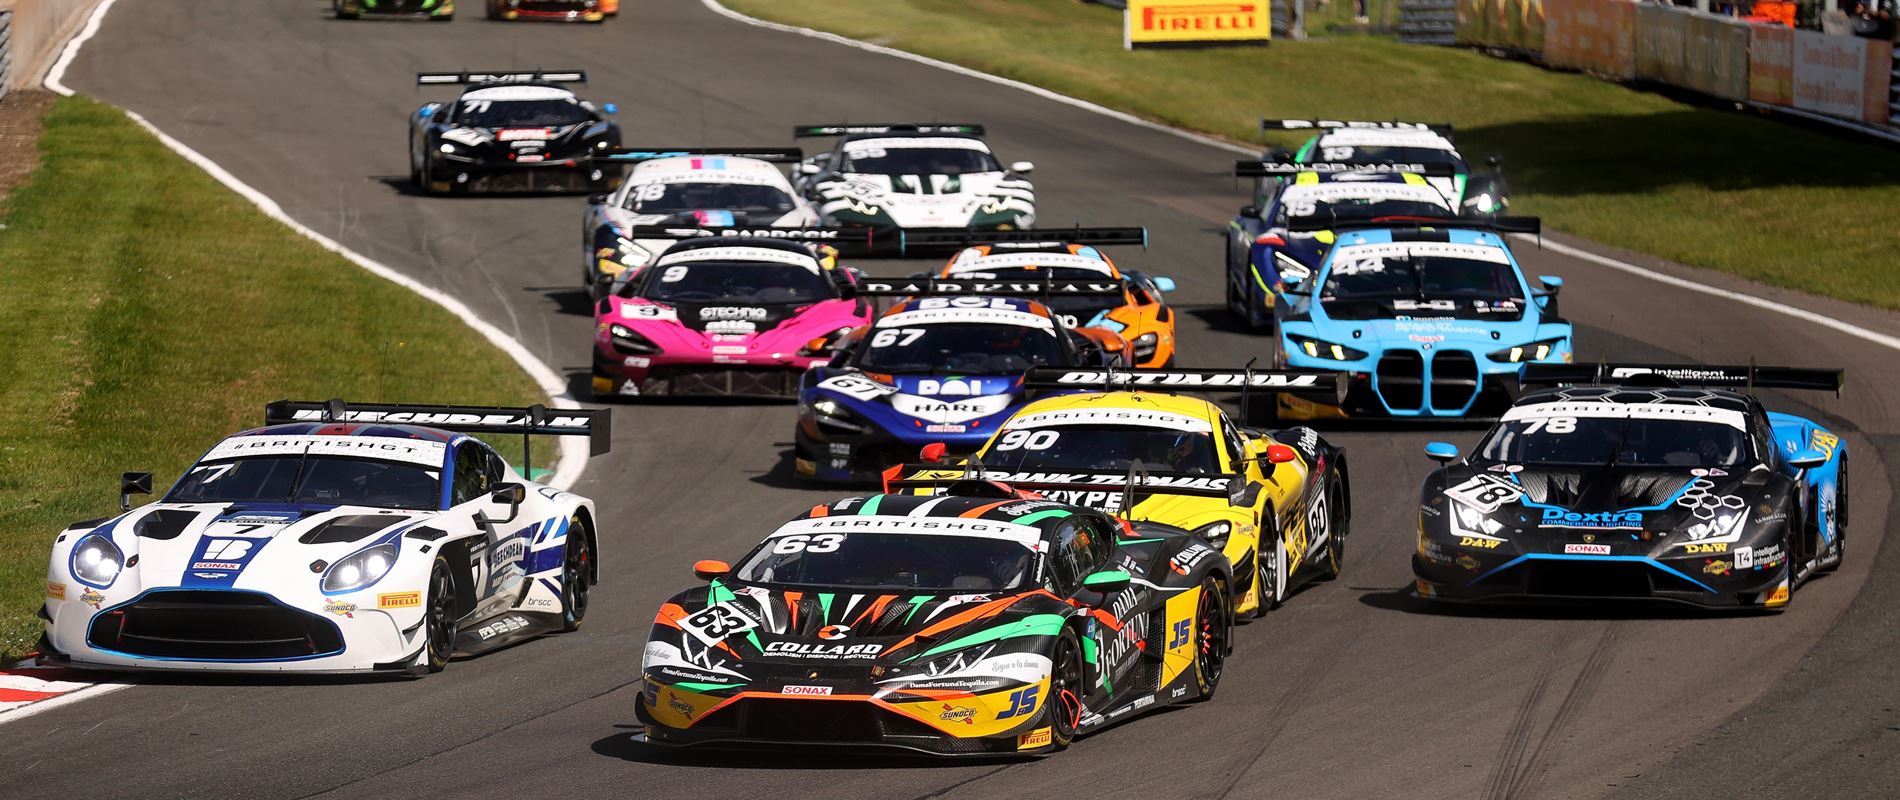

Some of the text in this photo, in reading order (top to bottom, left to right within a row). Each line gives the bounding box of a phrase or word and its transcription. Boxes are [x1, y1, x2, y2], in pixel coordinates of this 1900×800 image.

[1143, 4, 1256, 31] PIRELLI
[721, 229, 838, 239] PADDOCK
[1332, 256, 1386, 276] 44
[661, 265, 689, 283] 9
[870, 329, 926, 348] 67
[1057, 371, 1318, 386] OPTIMUM
[832, 379, 877, 393] 67
[914, 404, 986, 413] HARE
[1535, 406, 1718, 416] #BRITISHGT
[1016, 411, 1196, 425] #BRITISHGT
[1519, 417, 1578, 435] 78
[234, 440, 418, 453] #BRITISHGT
[995, 429, 1060, 452] 90
[190, 463, 235, 484] 7
[1458, 476, 1515, 505] 78
[1541, 518, 1599, 527] COMMERCIAL
[1542, 508, 1643, 523] Dextra
[234, 523, 265, 535] 7
[812, 519, 1013, 533] #BRITISHGT
[1310, 499, 1327, 547] 90
[772, 533, 846, 555] 63
[1566, 545, 1609, 554] SONAX
[194, 562, 238, 570] SONAX
[1737, 551, 1750, 567] T4
[381, 593, 419, 607] PIRELLI
[527, 597, 552, 606] brscc
[1112, 586, 1138, 623] DAMA
[325, 603, 356, 612] SUNOCO
[688, 605, 747, 639] 63
[762, 651, 802, 659] DEMOLISH
[765, 641, 884, 655] COLLARD
[783, 686, 830, 695] SONAX
[670, 700, 695, 713] SUNOCO
[942, 708, 976, 719] SUNOCO
[1021, 730, 1051, 746] PIRELLI
